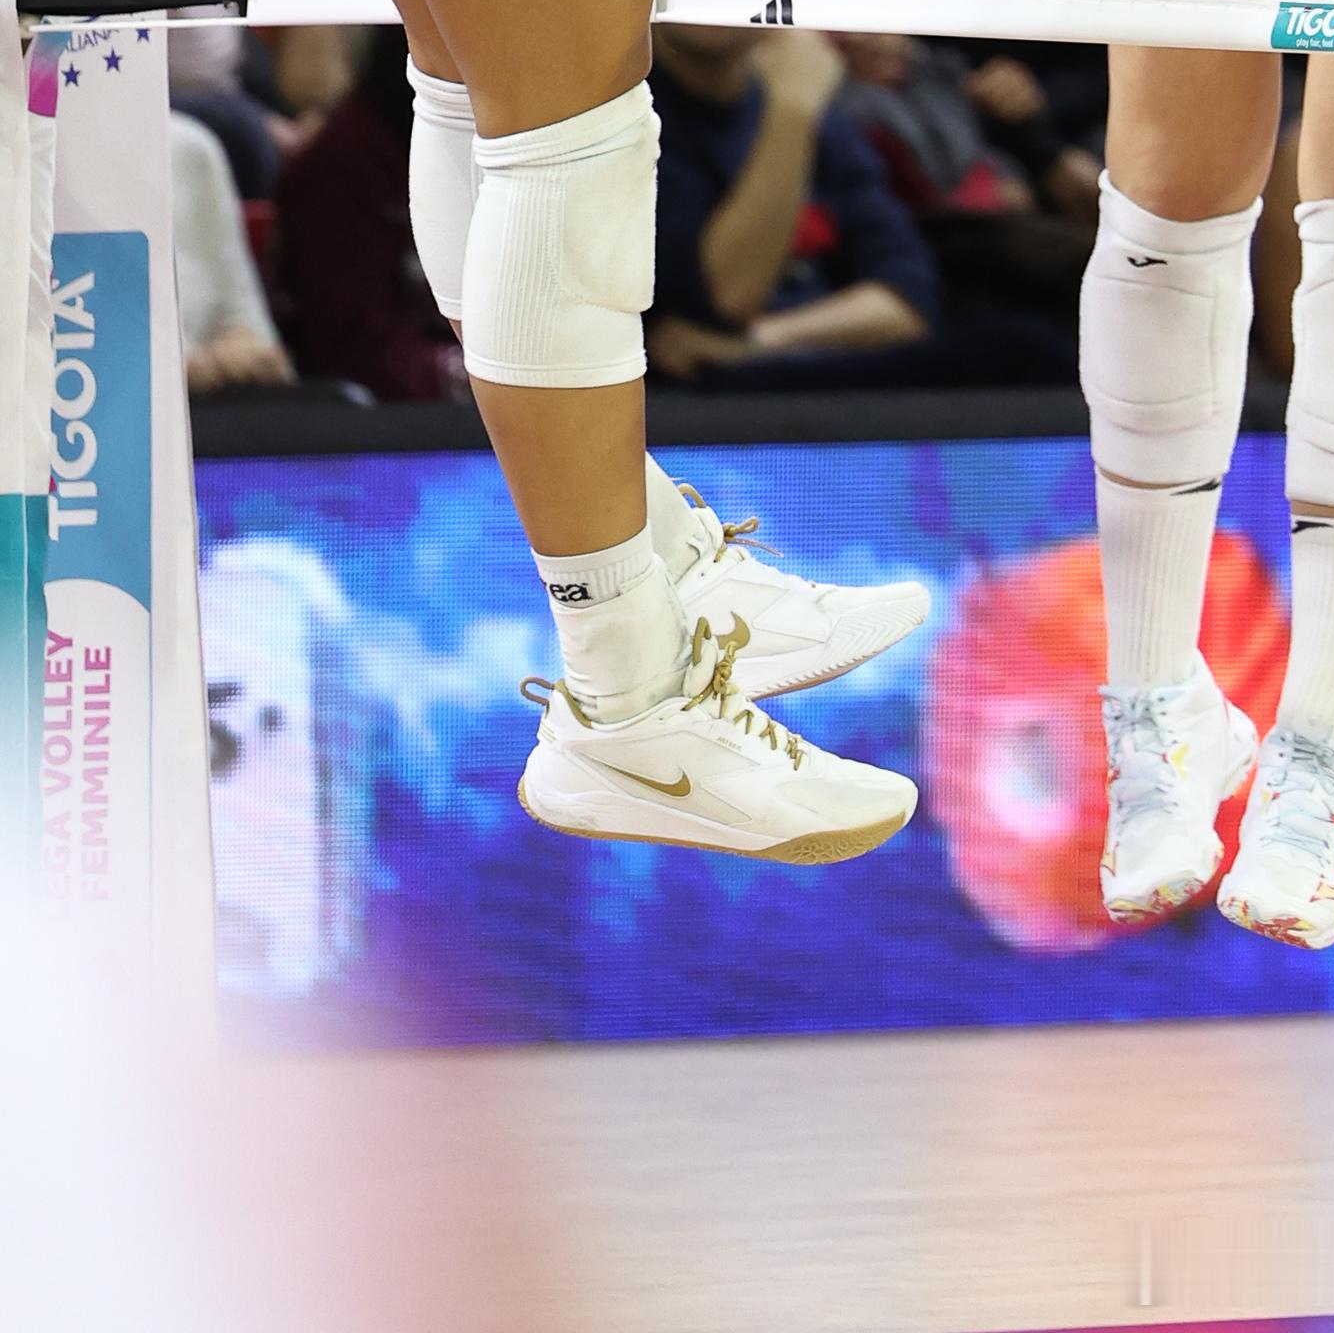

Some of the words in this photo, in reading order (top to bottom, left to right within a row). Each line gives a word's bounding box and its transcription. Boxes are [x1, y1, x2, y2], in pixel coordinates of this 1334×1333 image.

[44, 629, 73, 798] VOLLEY
[81, 646, 112, 901] FEMMINILE
[44, 810, 72, 901] EGA
